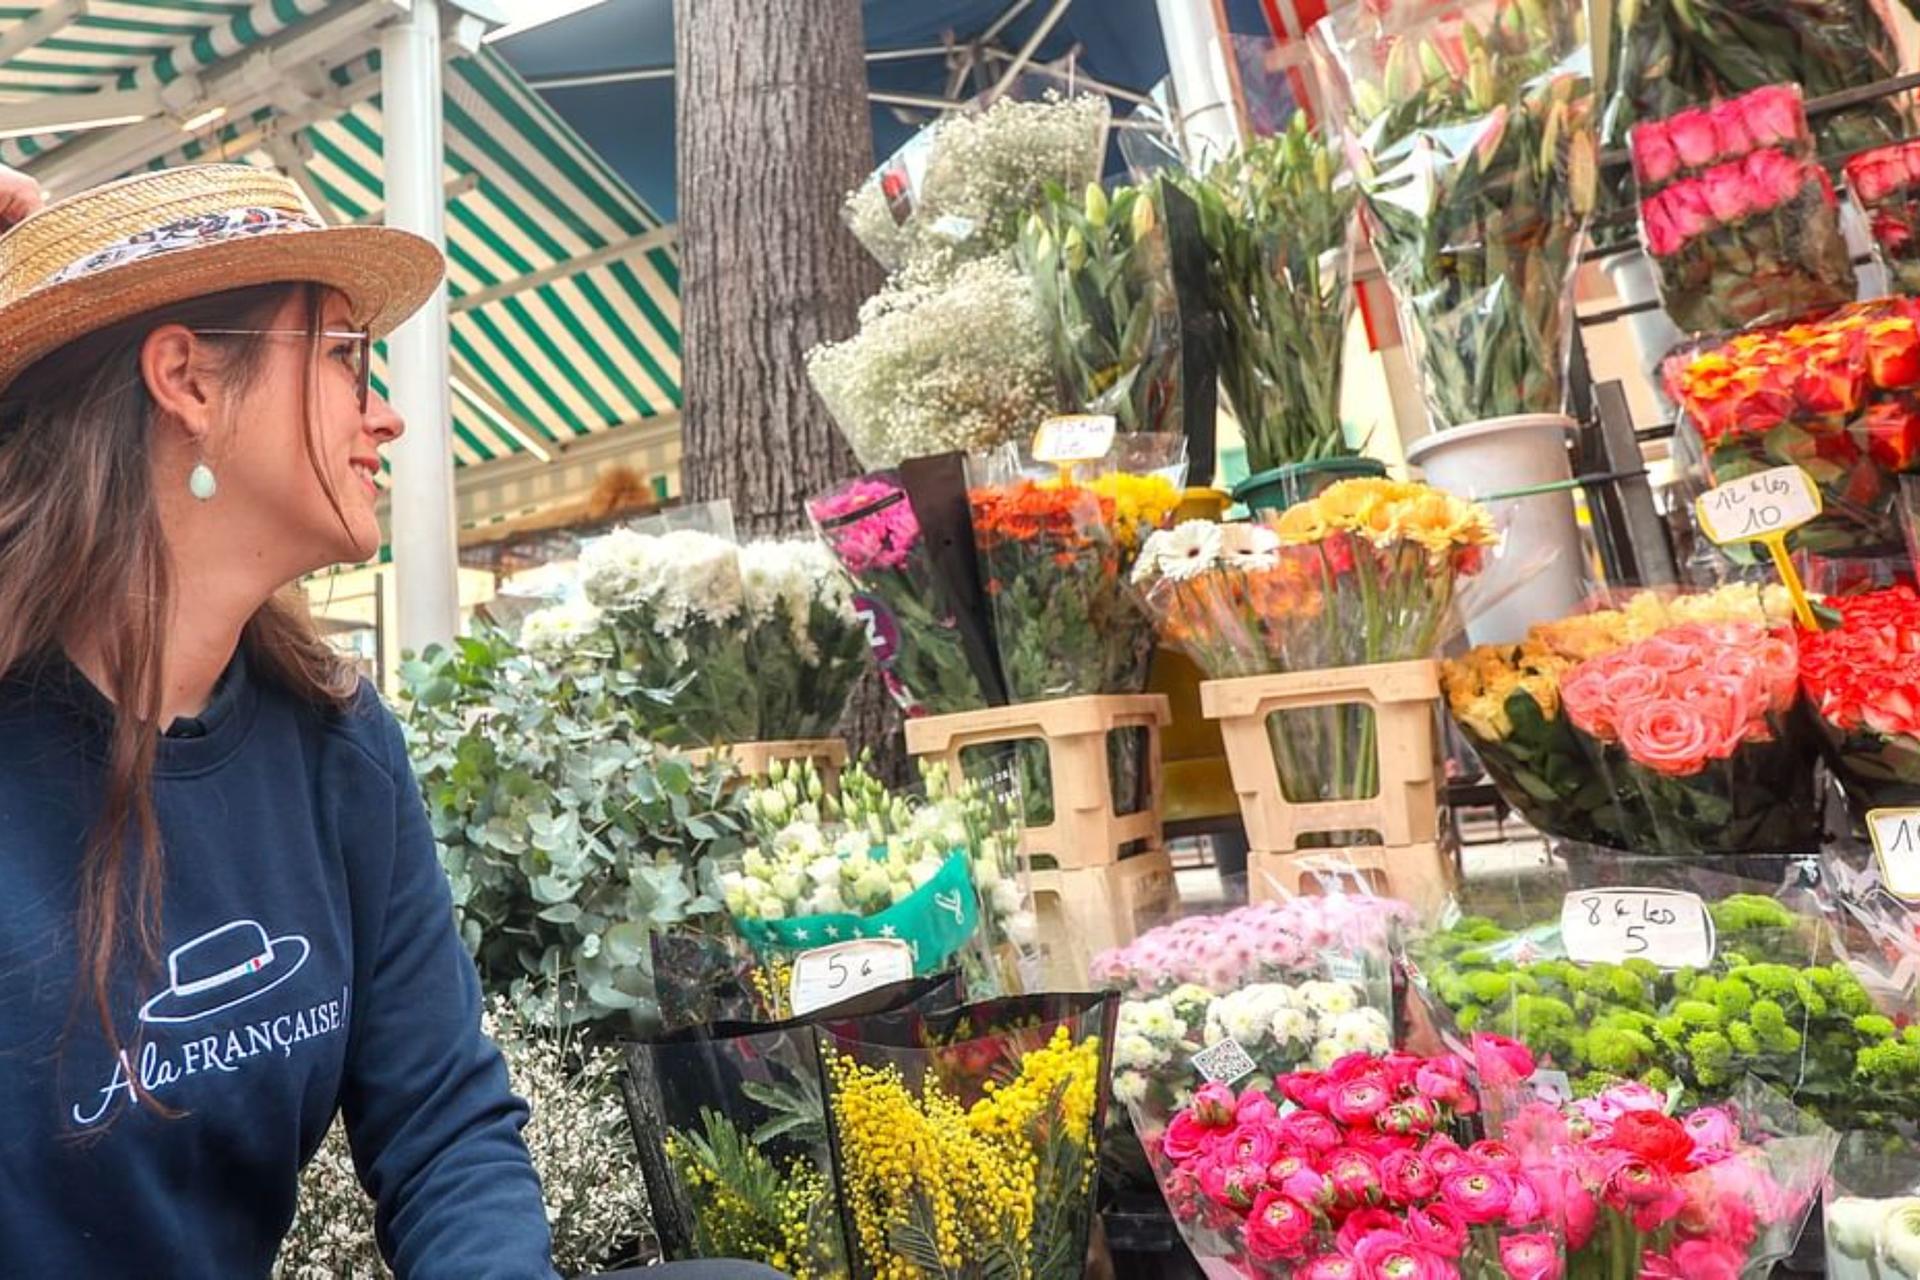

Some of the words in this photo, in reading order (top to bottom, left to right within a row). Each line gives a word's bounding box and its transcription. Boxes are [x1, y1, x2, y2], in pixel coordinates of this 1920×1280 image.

[1715, 487, 1747, 511] 12
[1739, 505, 1782, 534] 10
[1890, 817, 1920, 853] 1
[1581, 896, 1602, 926] 8
[1624, 925, 1649, 953] 5
[827, 952, 849, 989] 5
[139, 1041, 182, 1091] la
